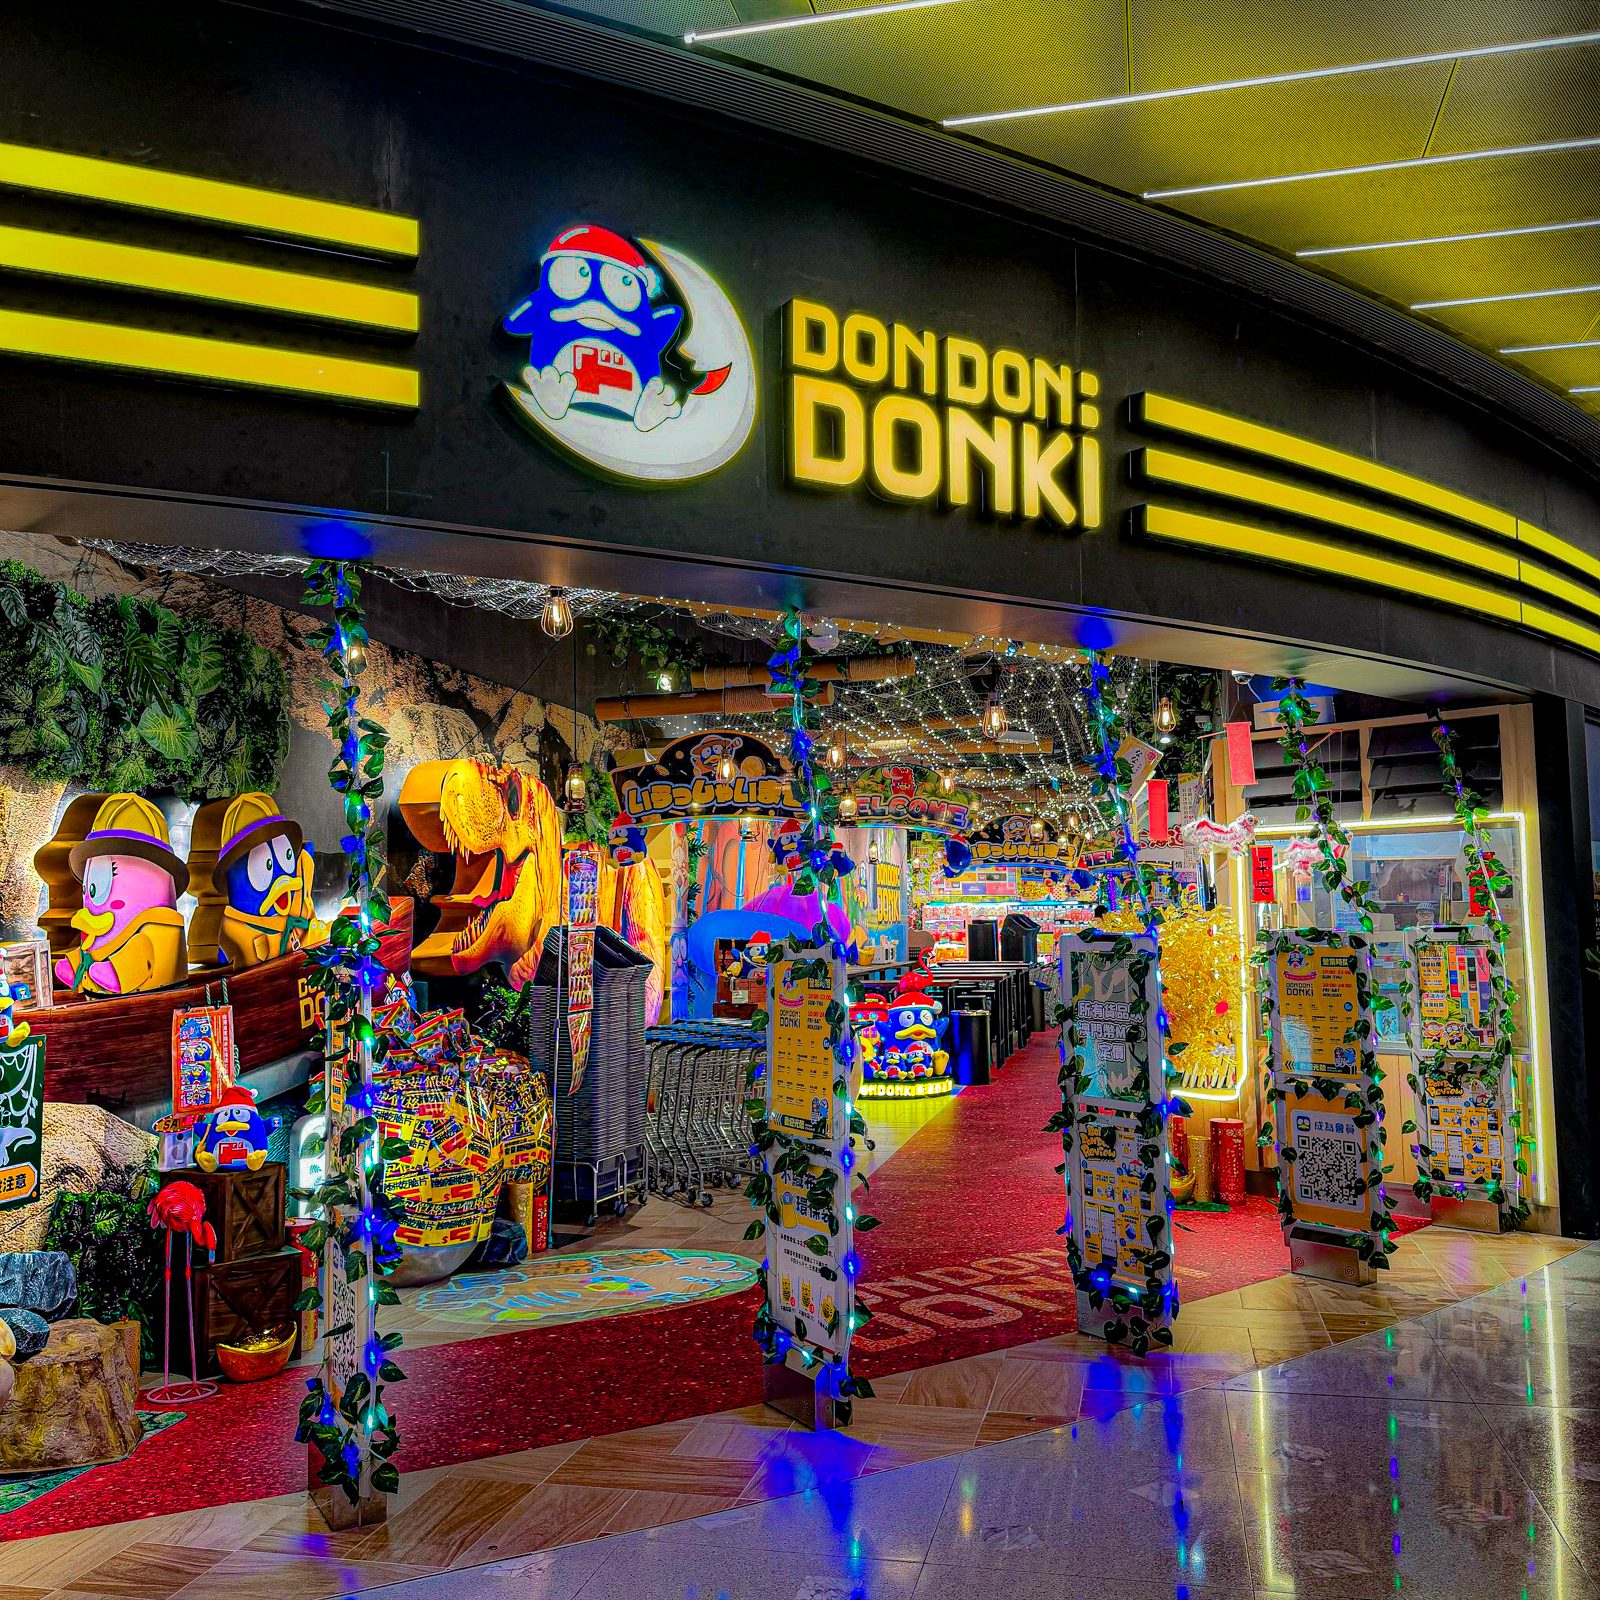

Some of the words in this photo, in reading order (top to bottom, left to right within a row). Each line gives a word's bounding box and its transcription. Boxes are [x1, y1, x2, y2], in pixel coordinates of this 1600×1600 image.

[793, 374, 1100, 529] DONKI
[855, 796, 968, 827] ELCOME
[1286, 988, 1314, 997] DONKI
[1078, 1020, 1146, 1042] 澳門幣M
[1098, 1043, 1126, 1062] 定價
[1314, 1120, 1355, 1134] 成為會員
[0, 1173, 27, 1193] 注意
